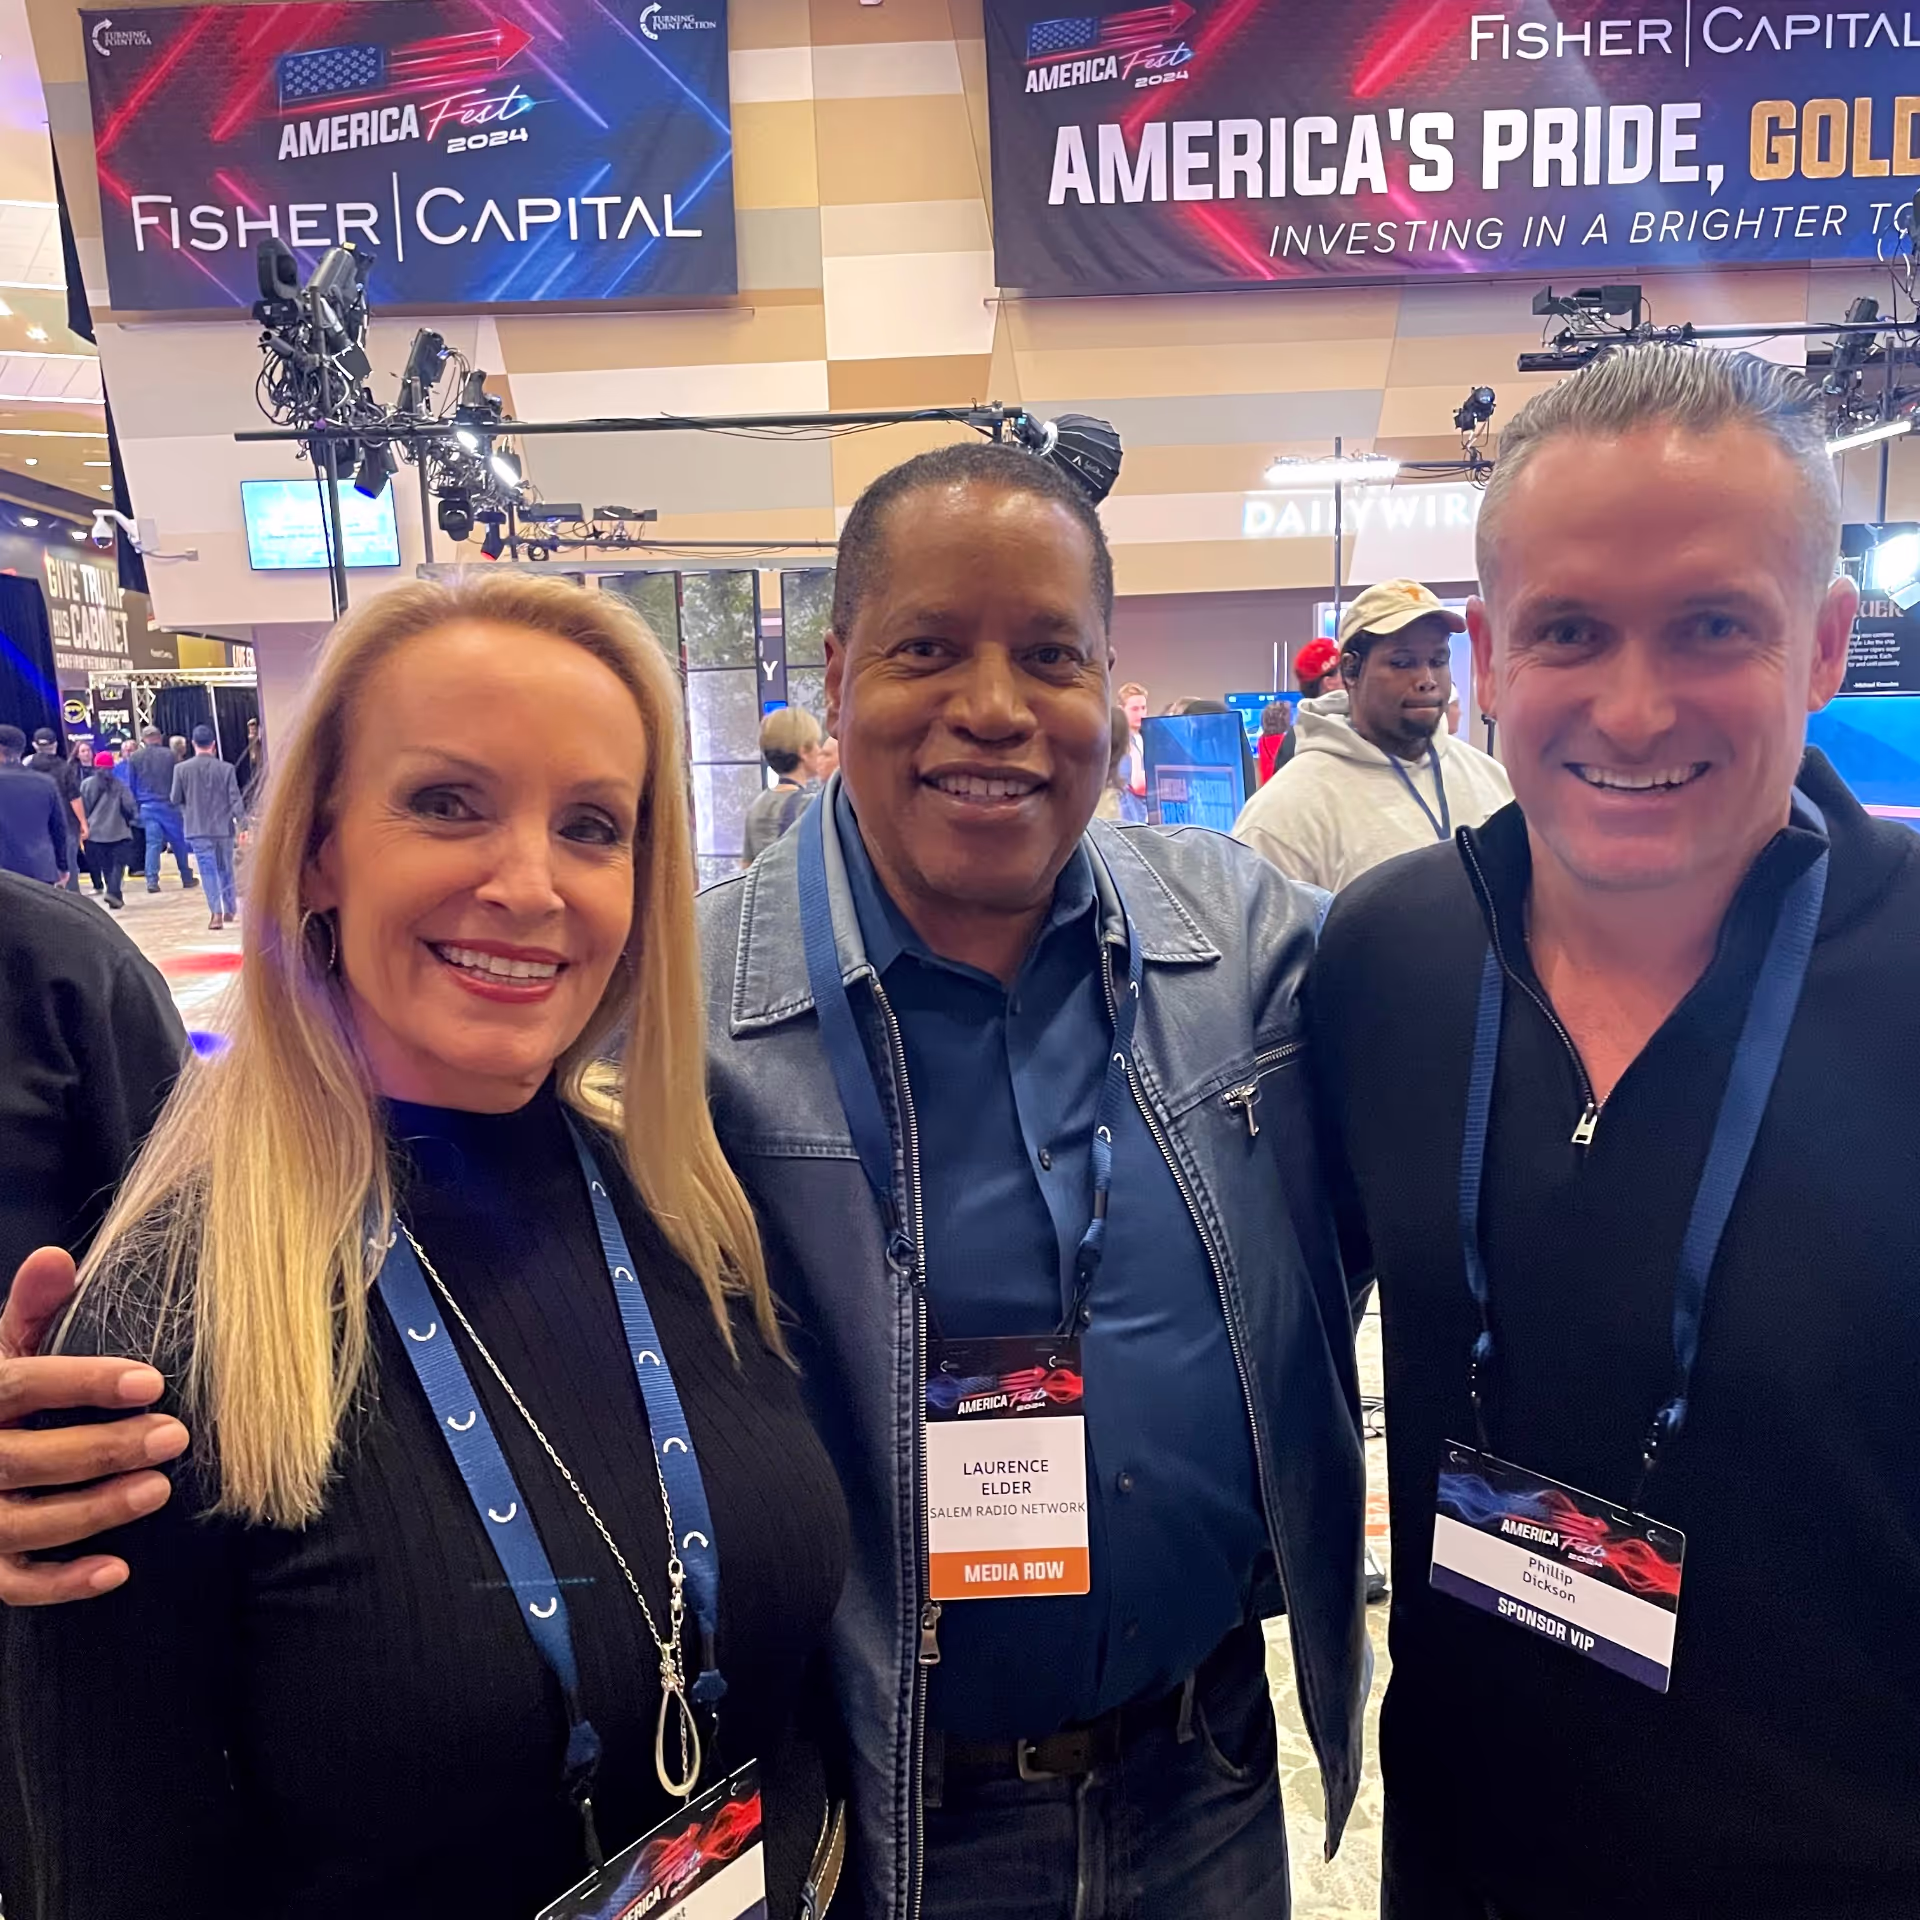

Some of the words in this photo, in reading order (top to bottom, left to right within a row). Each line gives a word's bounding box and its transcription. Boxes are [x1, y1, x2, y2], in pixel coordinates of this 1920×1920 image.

[652, 14, 695, 22] TURNING
[652, 21, 680, 30] POINT
[682, 21, 717, 29] ACTION
[1470, 14, 1672, 60] FISHER
[1703, 6, 1920, 55] CAPITAL
[1024, 55, 1119, 93] AMERICA
[1118, 41, 1194, 81] Fest
[1134, 70, 1189, 89] 2024
[278, 103, 420, 161] AMERICA
[420, 84, 531, 142] Fest
[446, 127, 529, 154] 2024
[1048, 107, 1454, 206] AMERICA'S
[1482, 102, 1724, 197] PRIDE,
[131, 194, 381, 252] FISHER
[415, 186, 703, 245] CAPITAL
[1269, 216, 1504, 257] INVESTING
[1522, 214, 1566, 248] IN
[1581, 213, 1608, 246] A
[1629, 204, 1848, 244] BRIGHTER
[1242, 495, 1482, 534] DAILYWIR
[44, 557, 81, 602] GIVE
[51, 608, 71, 638] HIS
[69, 603, 129, 654] CABINET
[957, 1394, 1008, 1415] AMERICA
[963, 1459, 1050, 1476] LAURENCE
[981, 1481, 1032, 1496] ELDER
[929, 1506, 973, 1519] SALEM
[975, 1504, 1018, 1517] RADIO
[1020, 1501, 1086, 1515] NETWORK
[1500, 1519, 1559, 1547] AMERICA
[964, 1563, 1020, 1583] MEDIA
[1023, 1560, 1065, 1580] ROW
[1522, 1570, 1577, 1604] Dickson
[1528, 1556, 1574, 1586] Phillip
[1497, 1596, 1567, 1642] SPONSOR
[1570, 1628, 1595, 1652] VIP
